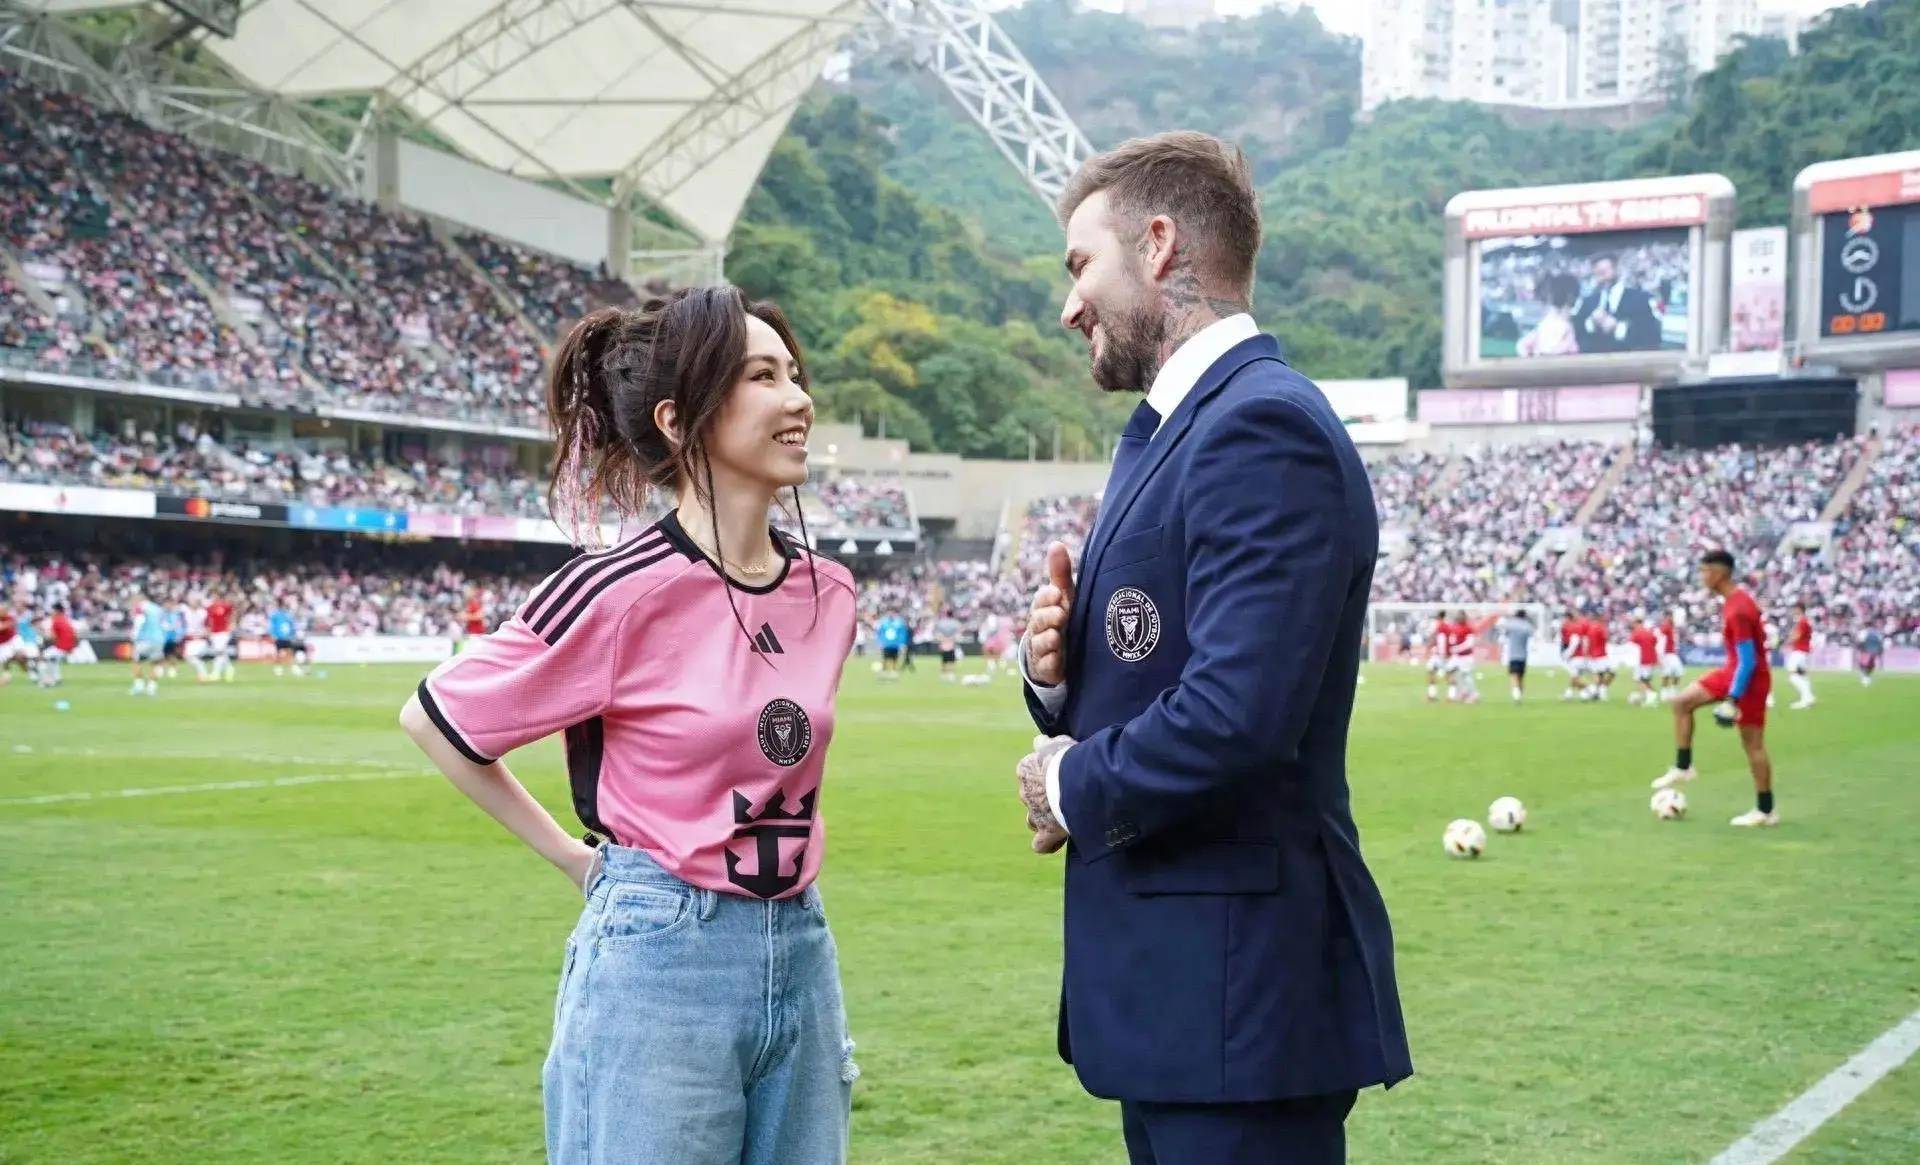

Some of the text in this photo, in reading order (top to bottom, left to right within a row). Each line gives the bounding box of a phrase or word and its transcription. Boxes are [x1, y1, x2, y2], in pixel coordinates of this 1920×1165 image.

[1118, 607, 1140, 615] MIAMI
[1144, 602, 1154, 613] DE
[1122, 650, 1142, 659] MMXX
[759, 701, 798, 731] INTERNACIONAL
[797, 711, 806, 720] DE
[759, 734, 769, 753] CLUB
